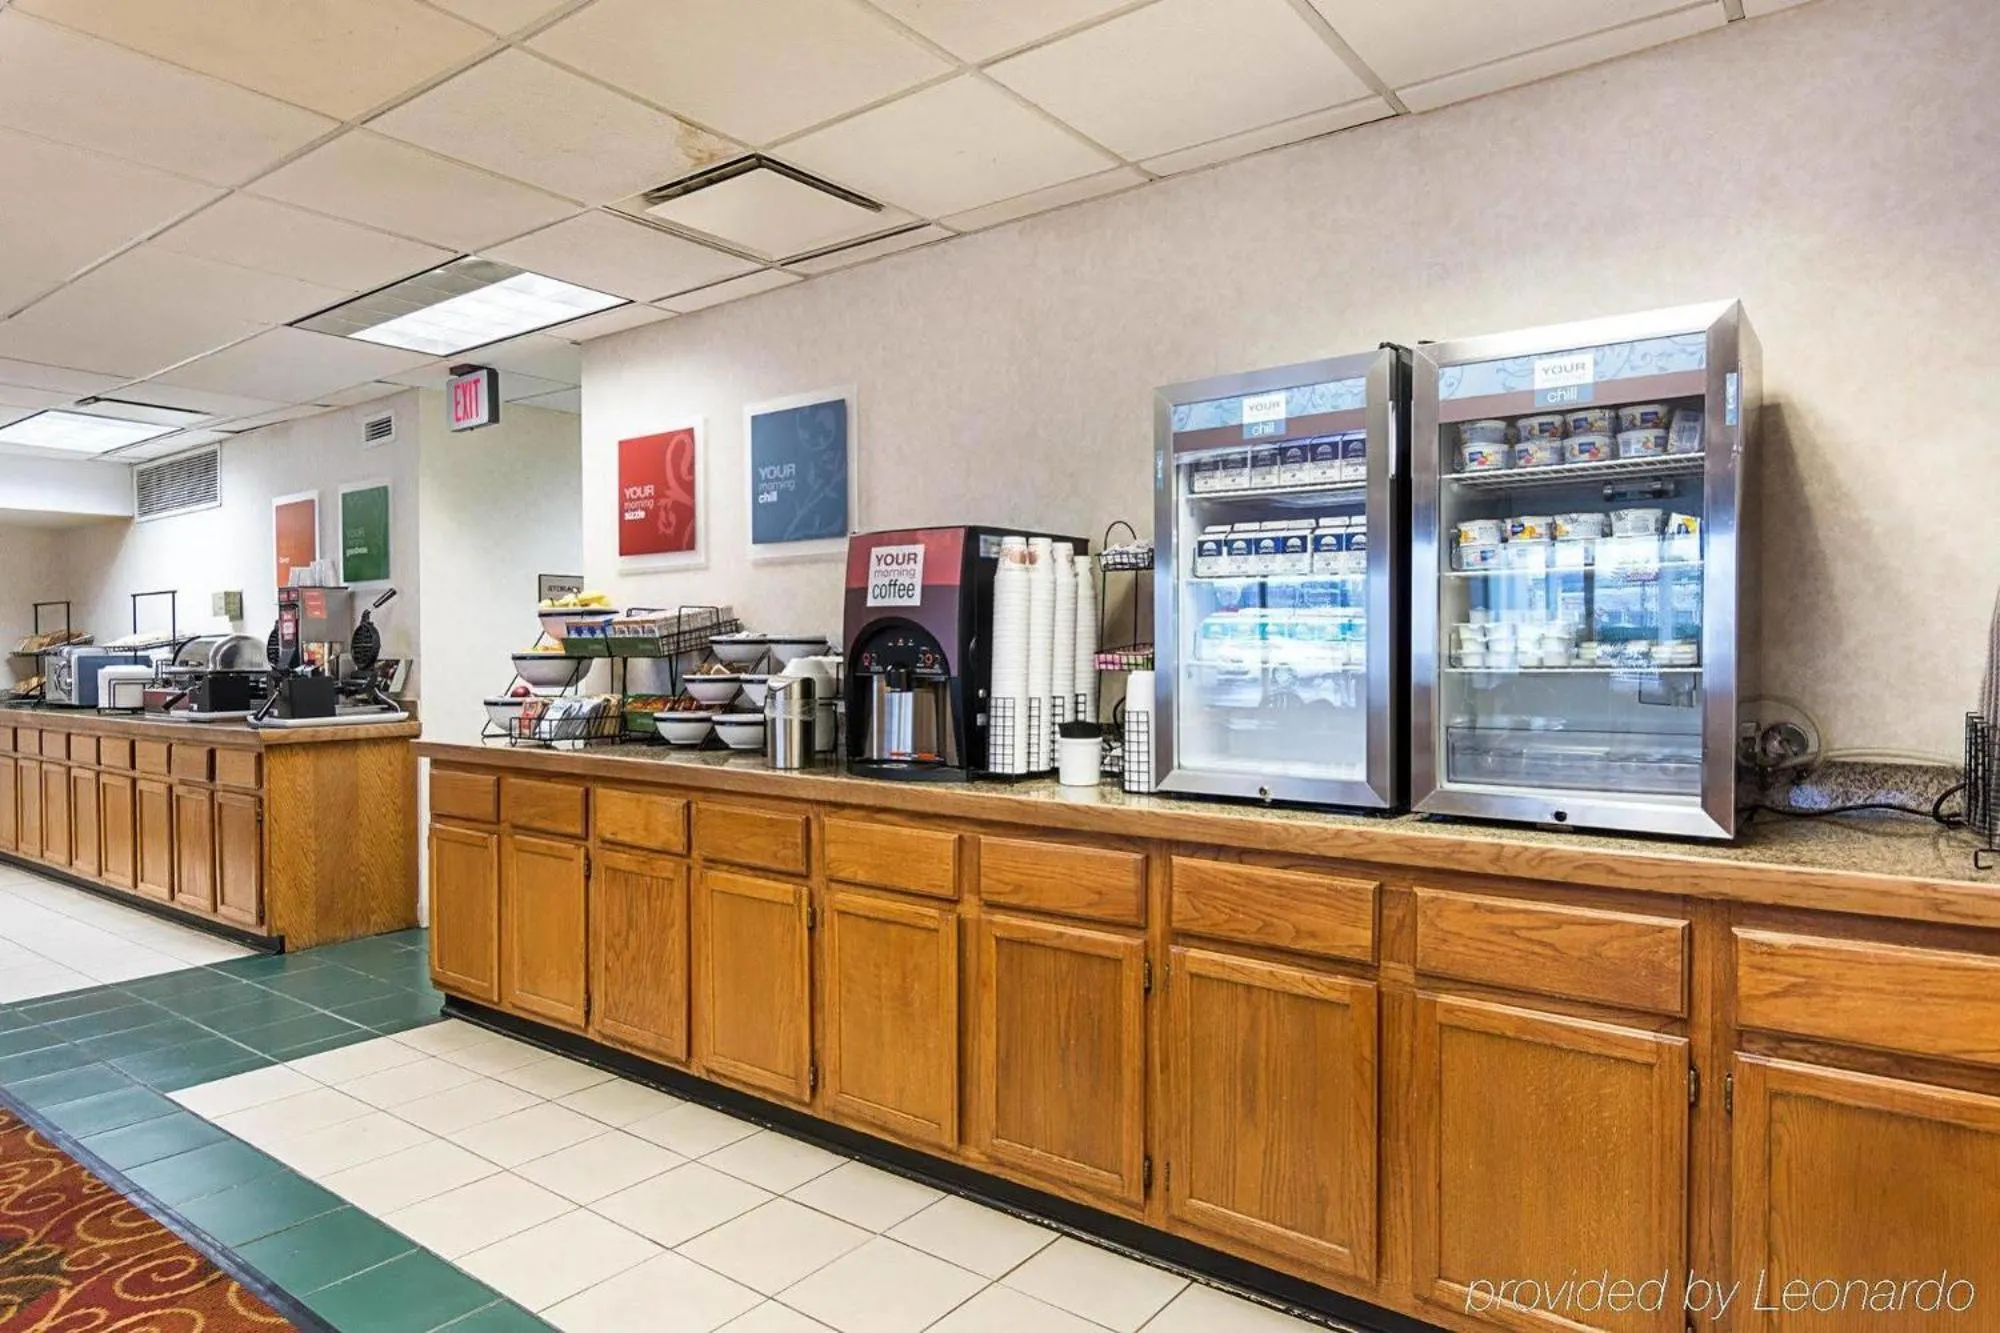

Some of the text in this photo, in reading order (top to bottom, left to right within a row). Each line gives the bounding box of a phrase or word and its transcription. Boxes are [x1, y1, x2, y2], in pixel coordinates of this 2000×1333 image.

[1541, 362, 1586, 376] YOUR
[454, 378, 481, 422] EXIT
[1547, 386, 1577, 403] chill
[1251, 421, 1276, 436] chill
[758, 463, 796, 481] YOUR
[624, 484, 655, 500] YOUR
[758, 490, 778, 504] chill
[875, 552, 918, 567] YOUR
[874, 567, 917, 579] morning
[547, 584, 582, 595] STORA
[872, 579, 916, 600] coffee
